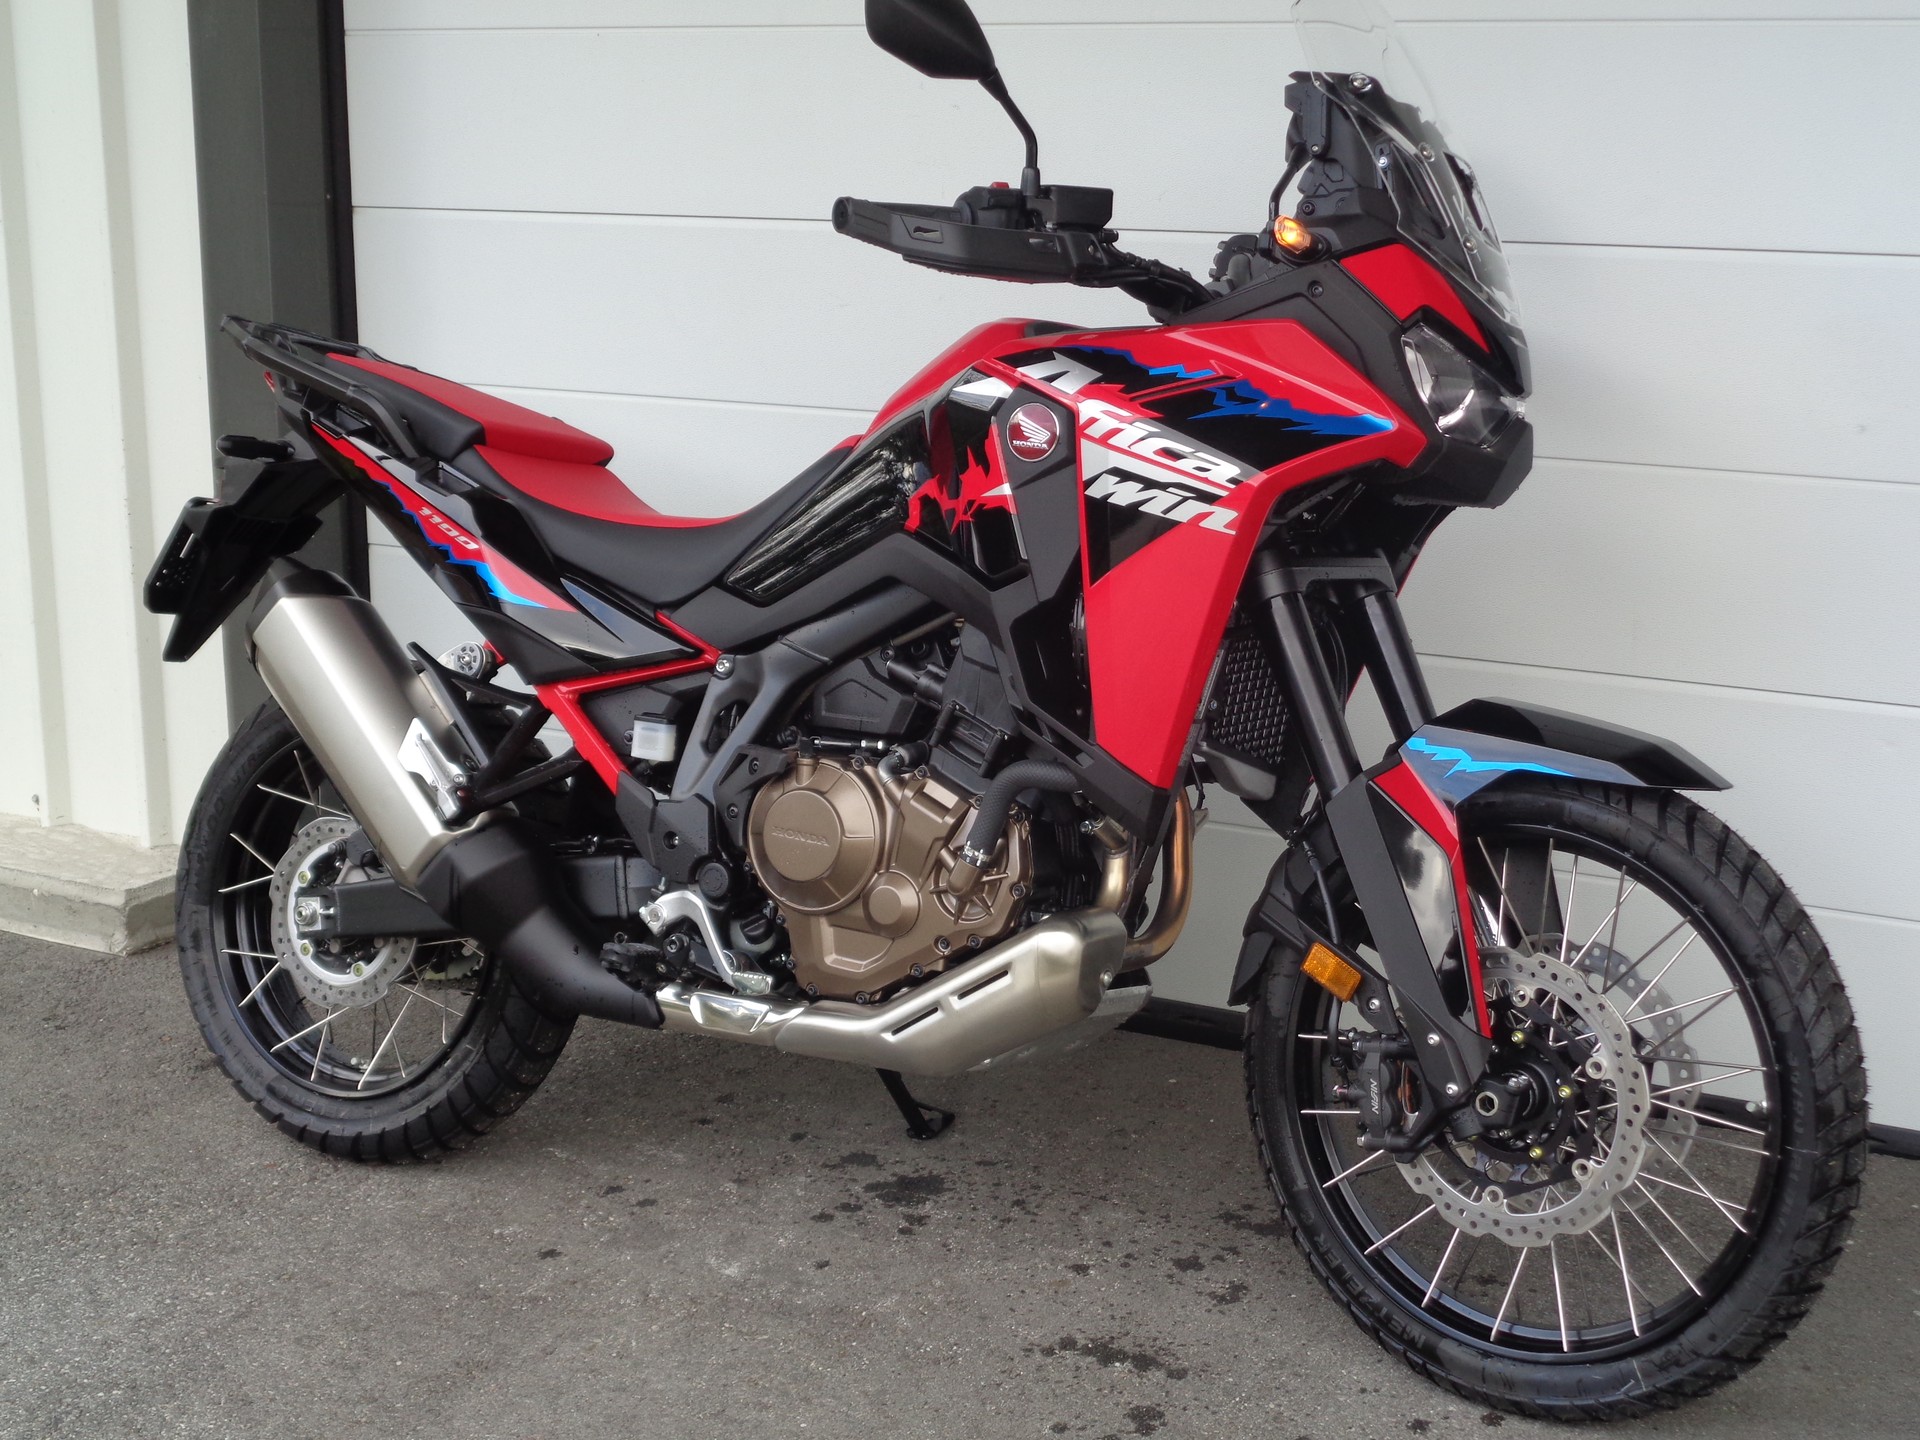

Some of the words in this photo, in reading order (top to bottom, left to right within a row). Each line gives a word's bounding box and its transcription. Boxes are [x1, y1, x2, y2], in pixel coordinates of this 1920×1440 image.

[1012, 440, 1049, 450] HONDA
[418, 506, 480, 549] 1100
[771, 826, 831, 847] HONDA
[1313, 1233, 1426, 1349] METZELER
